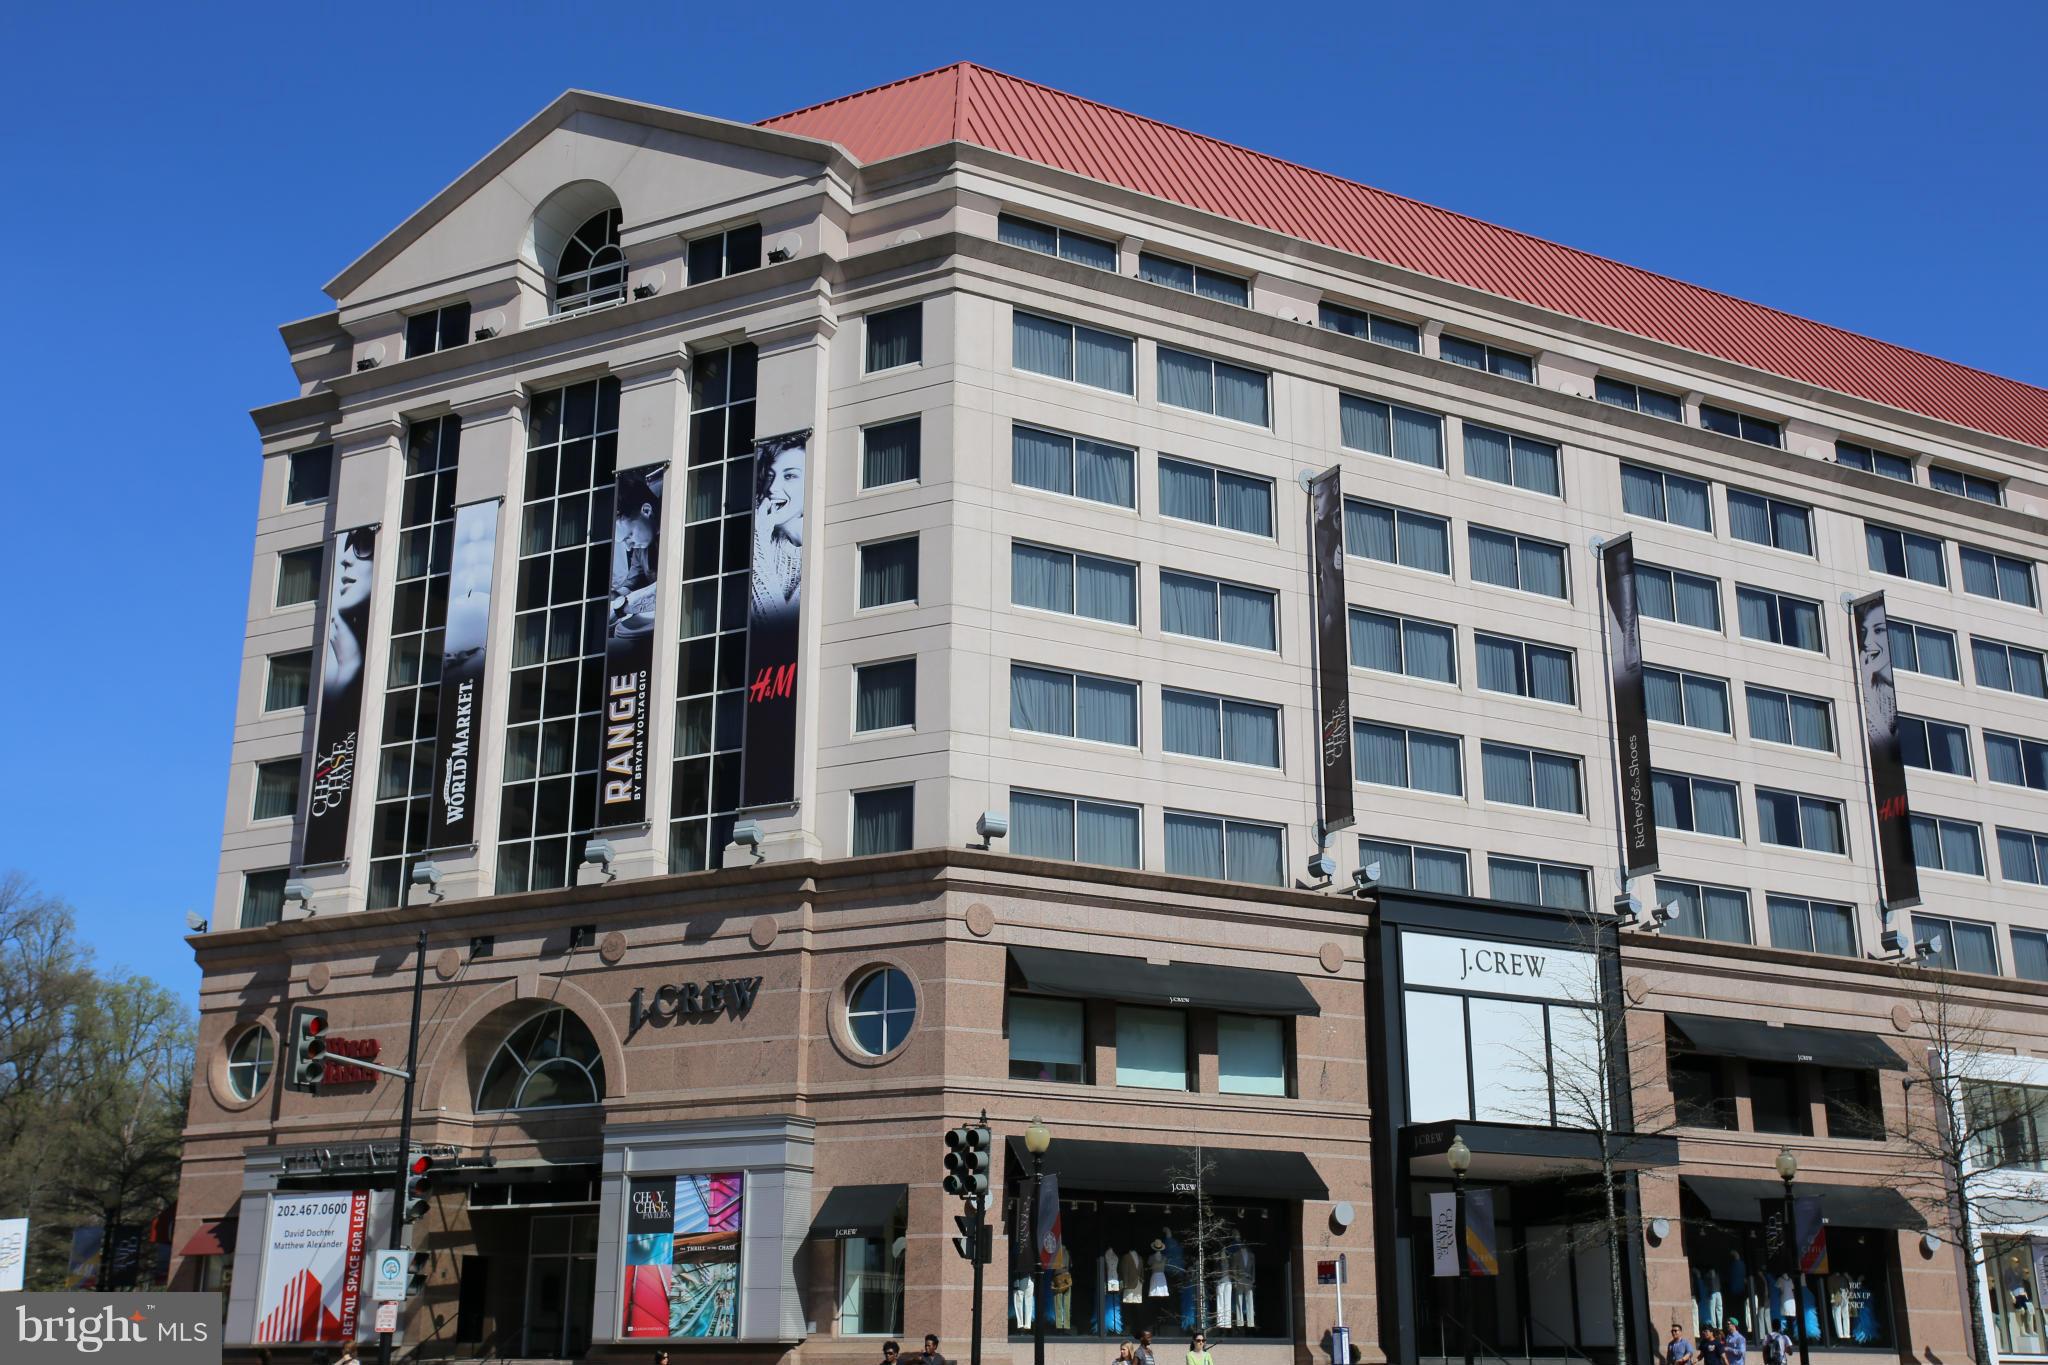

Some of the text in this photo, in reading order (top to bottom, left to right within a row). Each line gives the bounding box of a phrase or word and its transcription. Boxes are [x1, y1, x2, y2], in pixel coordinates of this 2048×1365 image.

[749, 662, 797, 703] H&M
[604, 671, 638, 805] RANGE
[633, 670, 647, 801] BY BRYAN VOLTAGGIO
[326, 740, 348, 808] CHASE
[341, 731, 356, 790] PAVILION
[312, 752, 333, 817] CHEVY
[446, 758, 467, 825] WORLD
[1460, 947, 1546, 980] J.CREW
[627, 975, 764, 1035] J.CREW
[1171, 1183, 1197, 1193] J.CREW
[277, 1202, 347, 1217] 202.467.0600
[636, 1201, 669, 1214] CHASE
[274, 1240, 343, 1250] Matthew Alexander
[284, 1228, 335, 1238] David Dochter
[835, 1228, 858, 1238] J.CREW
[342, 1195, 367, 1336] RETAIL SPACE FOR LEASE
[1849, 1281, 1862, 1290] YOU
[1862, 1292, 1871, 1300] UP
[1849, 1301, 1865, 1309] NICE
